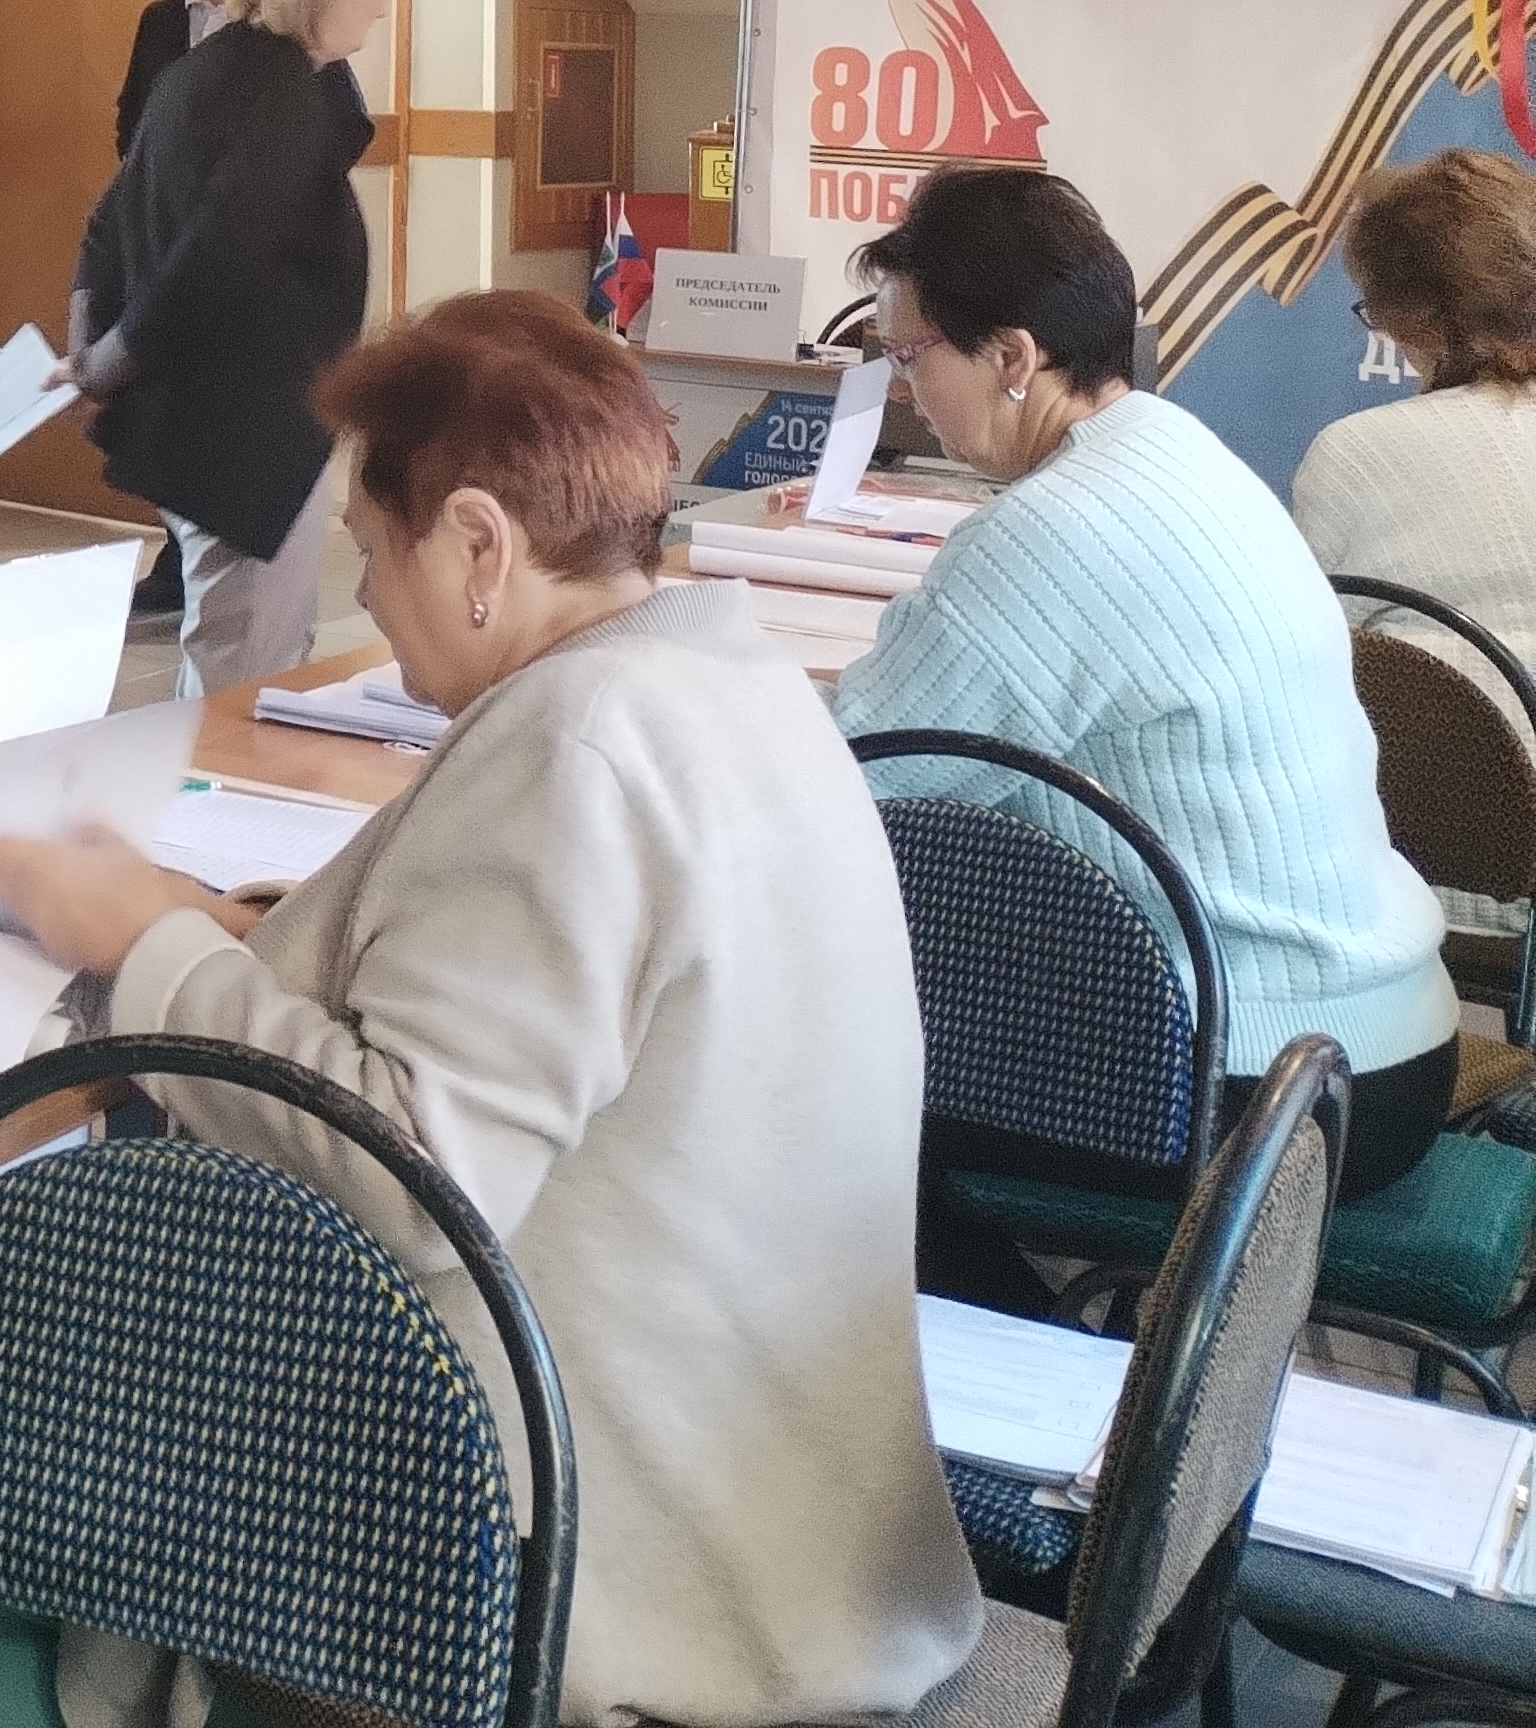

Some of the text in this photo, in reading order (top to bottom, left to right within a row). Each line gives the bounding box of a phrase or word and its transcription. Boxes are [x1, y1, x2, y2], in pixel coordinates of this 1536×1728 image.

[809, 46, 940, 153] 80
[809, 168, 910, 224] ПОБ
[675, 277, 781, 294] ПРЕДСЕДАТЕЛЬ
[688, 296, 768, 312] КОМИССИИ
[780, 399, 792, 411] 14
[766, 414, 830, 453] 202
